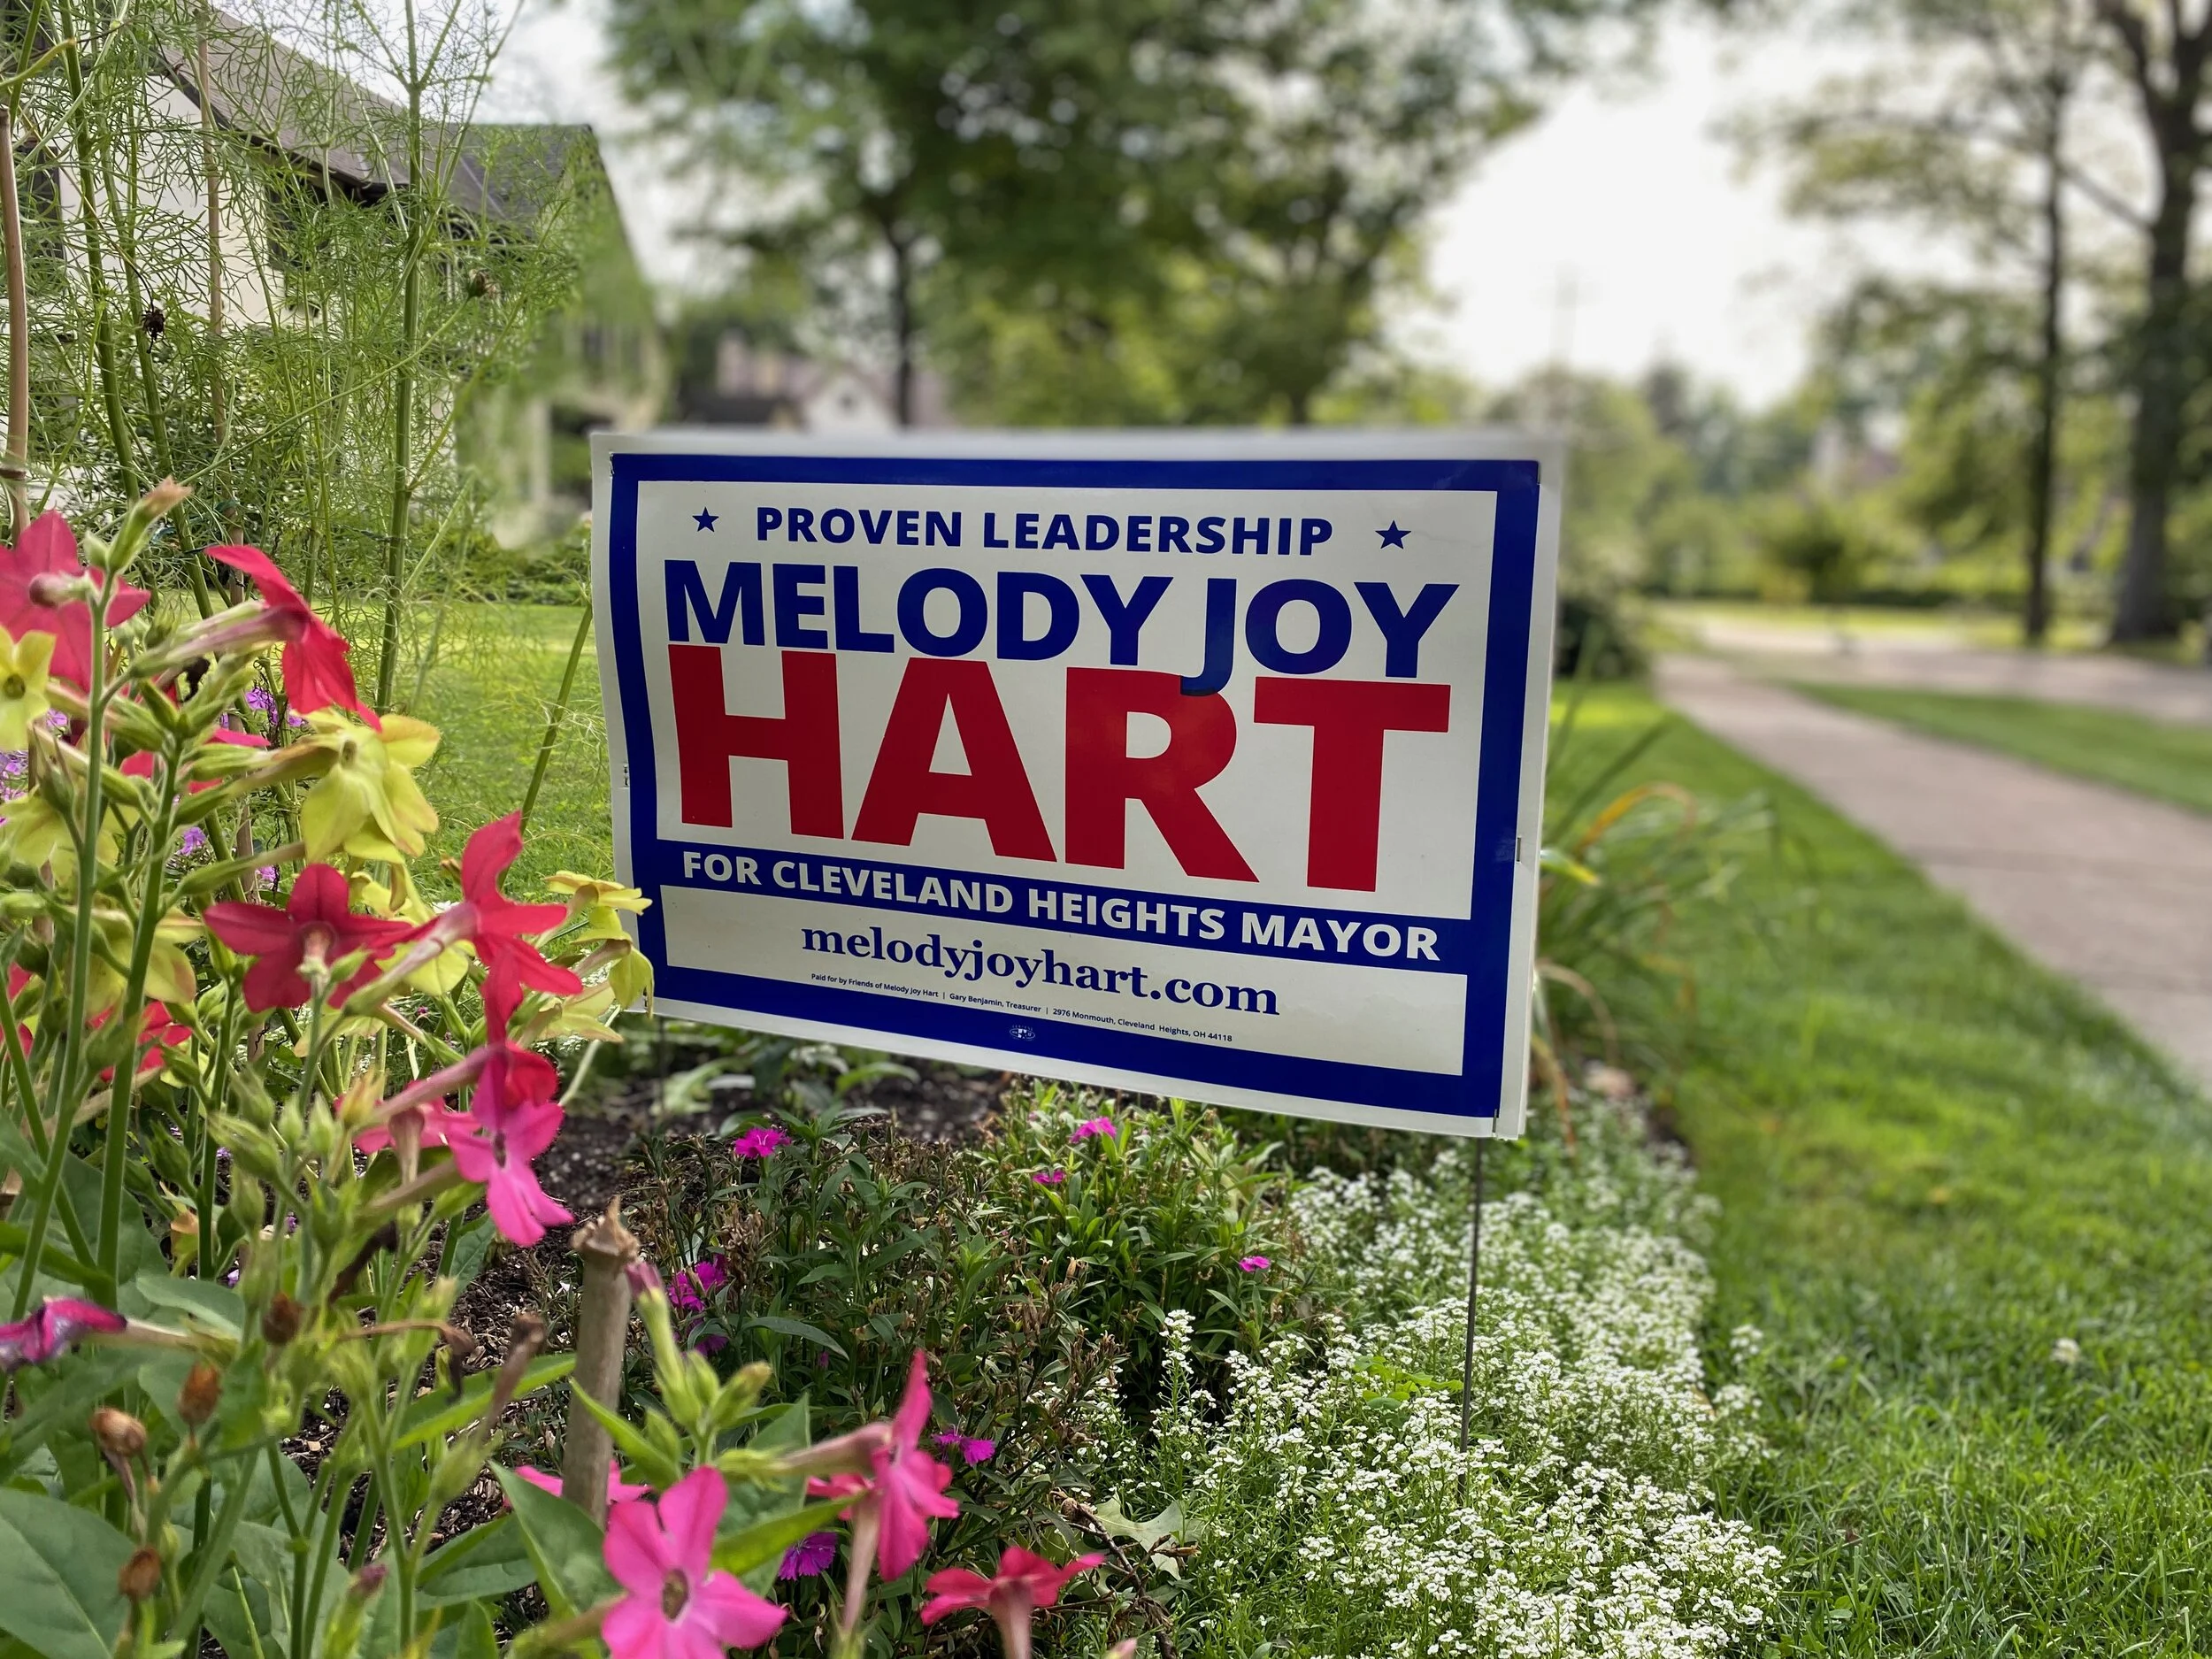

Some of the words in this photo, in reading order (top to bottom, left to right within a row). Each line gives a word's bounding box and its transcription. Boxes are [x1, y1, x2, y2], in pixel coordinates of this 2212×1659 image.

[757, 507, 962, 547] PROVEN
[983, 512, 1333, 556] LEADERSHIP
[664, 559, 1174, 666] MELODY
[1180, 577, 1460, 696] JOY
[668, 644, 1451, 893] HART
[682, 851, 760, 886] FOR
[772, 862, 1013, 913] CLEVELAND
[1028, 888, 1225, 940] HEIGHTS
[1241, 913, 1440, 961] MAYOR
[802, 926, 1279, 1016] melodyjoyhart.com
[839, 977, 848, 986] by
[849, 979, 874, 988] Friends
[884, 983, 910, 995] Melody
[922, 989, 939, 998] Hart
[949, 993, 967, 1002] Gary
[968, 995, 1004, 1008] Benjamin,
[1005, 1001, 1042, 1012] Treasurer
[1053, 1008, 1071, 1018] 2976
[1072, 1011, 1116, 1025] Monmouth,
[1118, 1018, 1156, 1031] Cleveland
[1158, 1025, 1191, 1038] Heights,
[1193, 1030, 1206, 1039] OH
[1207, 1032, 1233, 1042] 44118
